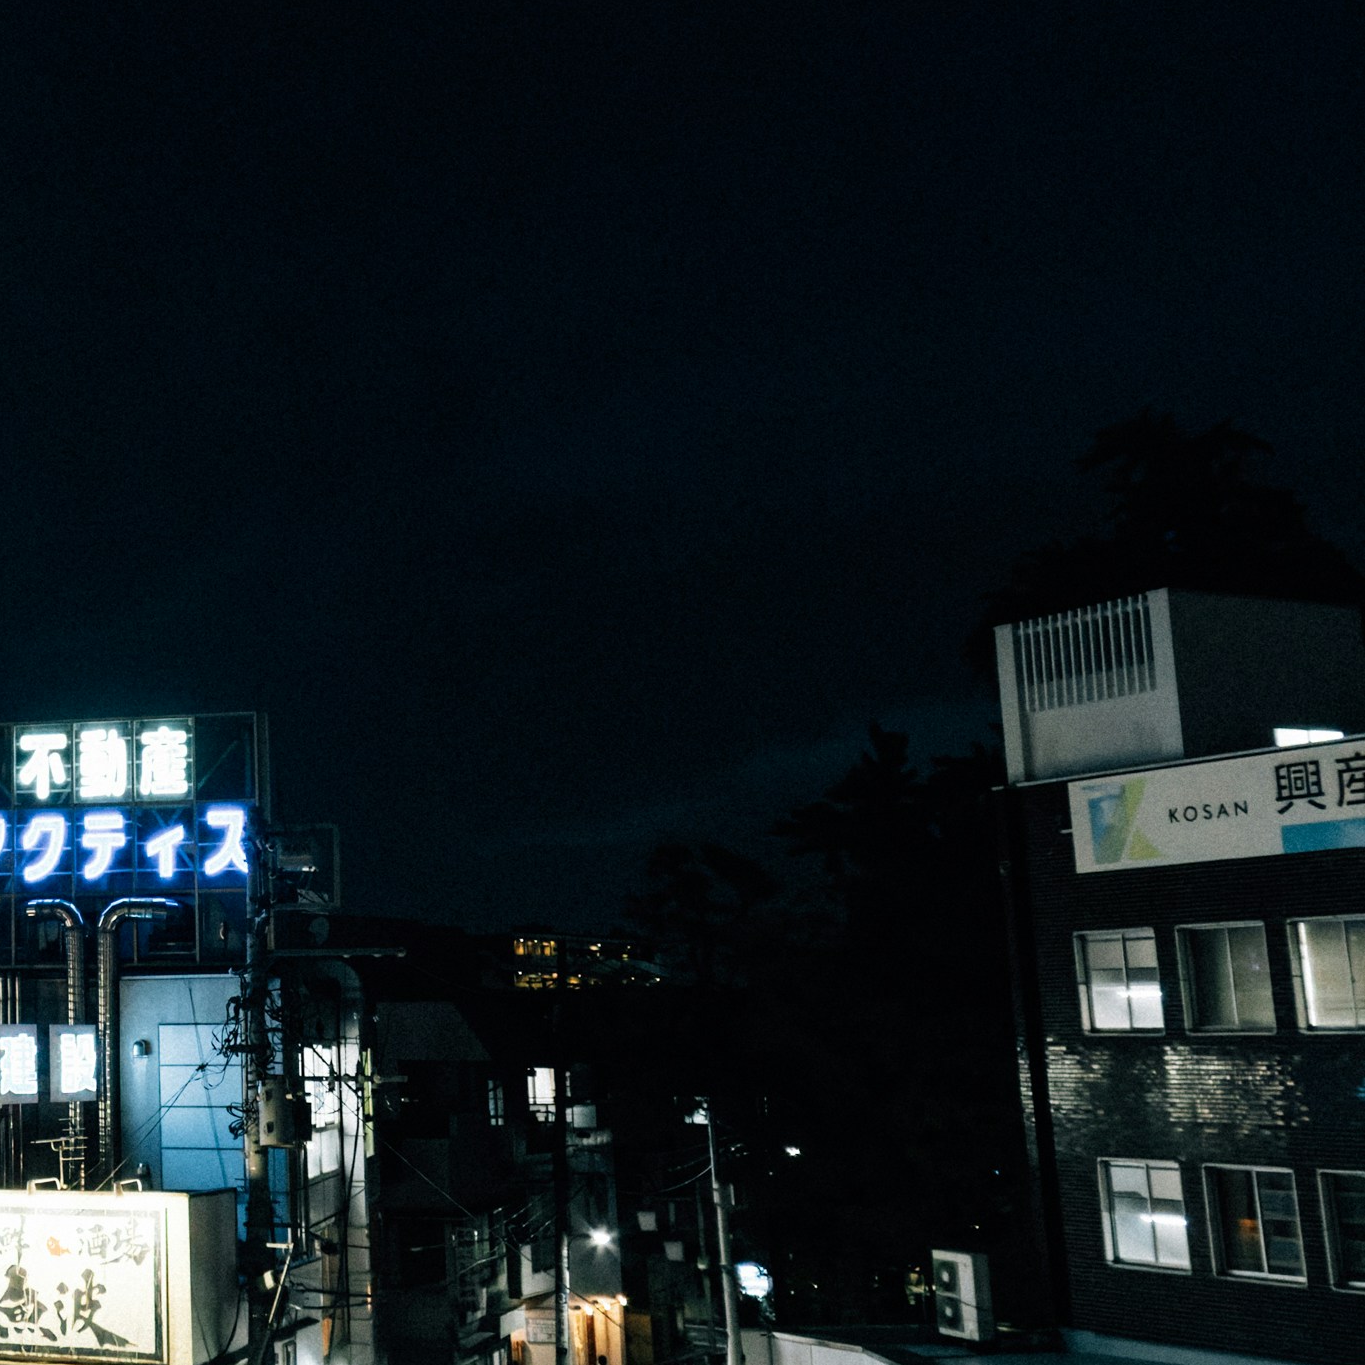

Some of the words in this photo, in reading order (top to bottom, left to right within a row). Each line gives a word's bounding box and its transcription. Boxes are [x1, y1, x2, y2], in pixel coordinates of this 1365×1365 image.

[18, 726, 189, 800] 不動産
[1168, 800, 1249, 825] KOSAN
[76, 1220, 150, 1266] 酒場
